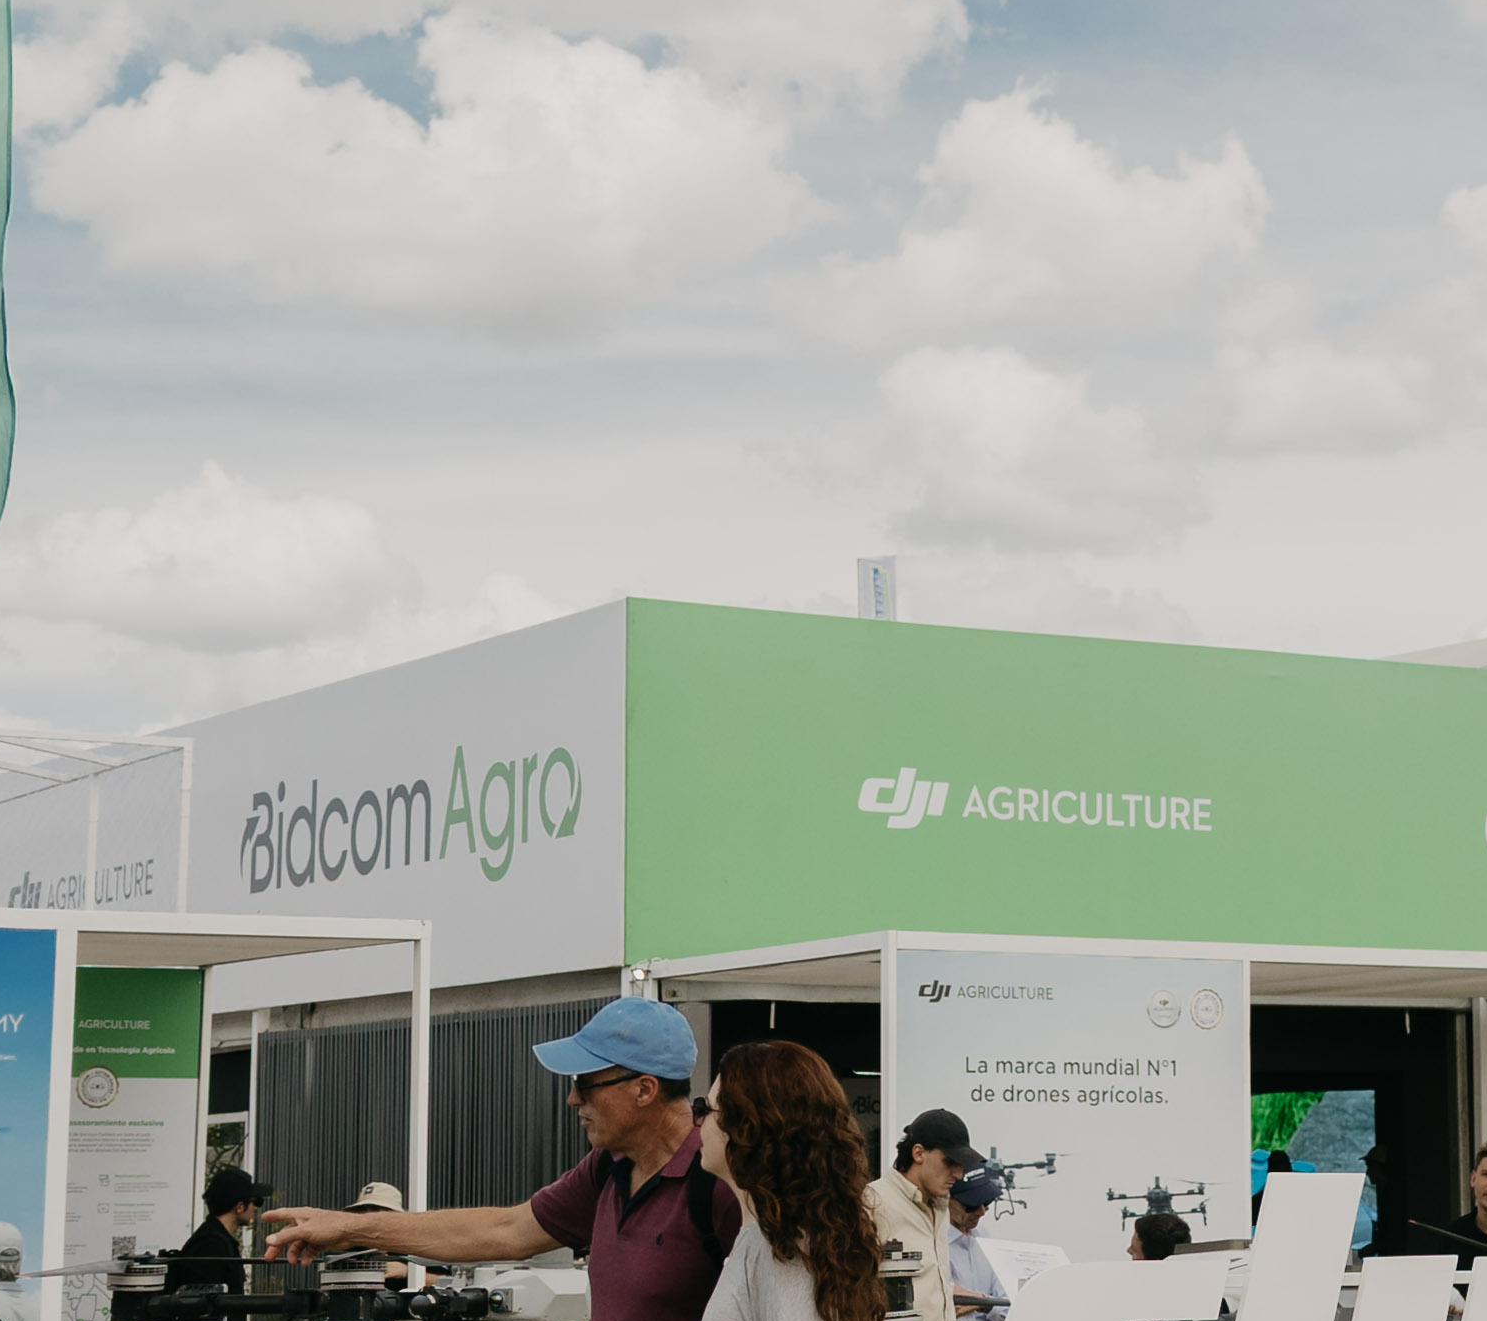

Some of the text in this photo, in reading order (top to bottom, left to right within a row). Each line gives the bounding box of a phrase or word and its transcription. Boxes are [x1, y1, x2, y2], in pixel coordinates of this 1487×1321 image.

[962, 785, 1212, 832] AGRICULTURE
[47, 859, 154, 909] AGRIULTURE
[957, 984, 1054, 1001] AGRICULTURE
[78, 1019, 151, 1030] AGRICULTURE
[965, 1056, 988, 1075] La
[996, 1061, 1056, 1075] marca
[1063, 1058, 1140, 1076] mundial
[970, 1084, 1169, 1105] de drones agrícolas.
